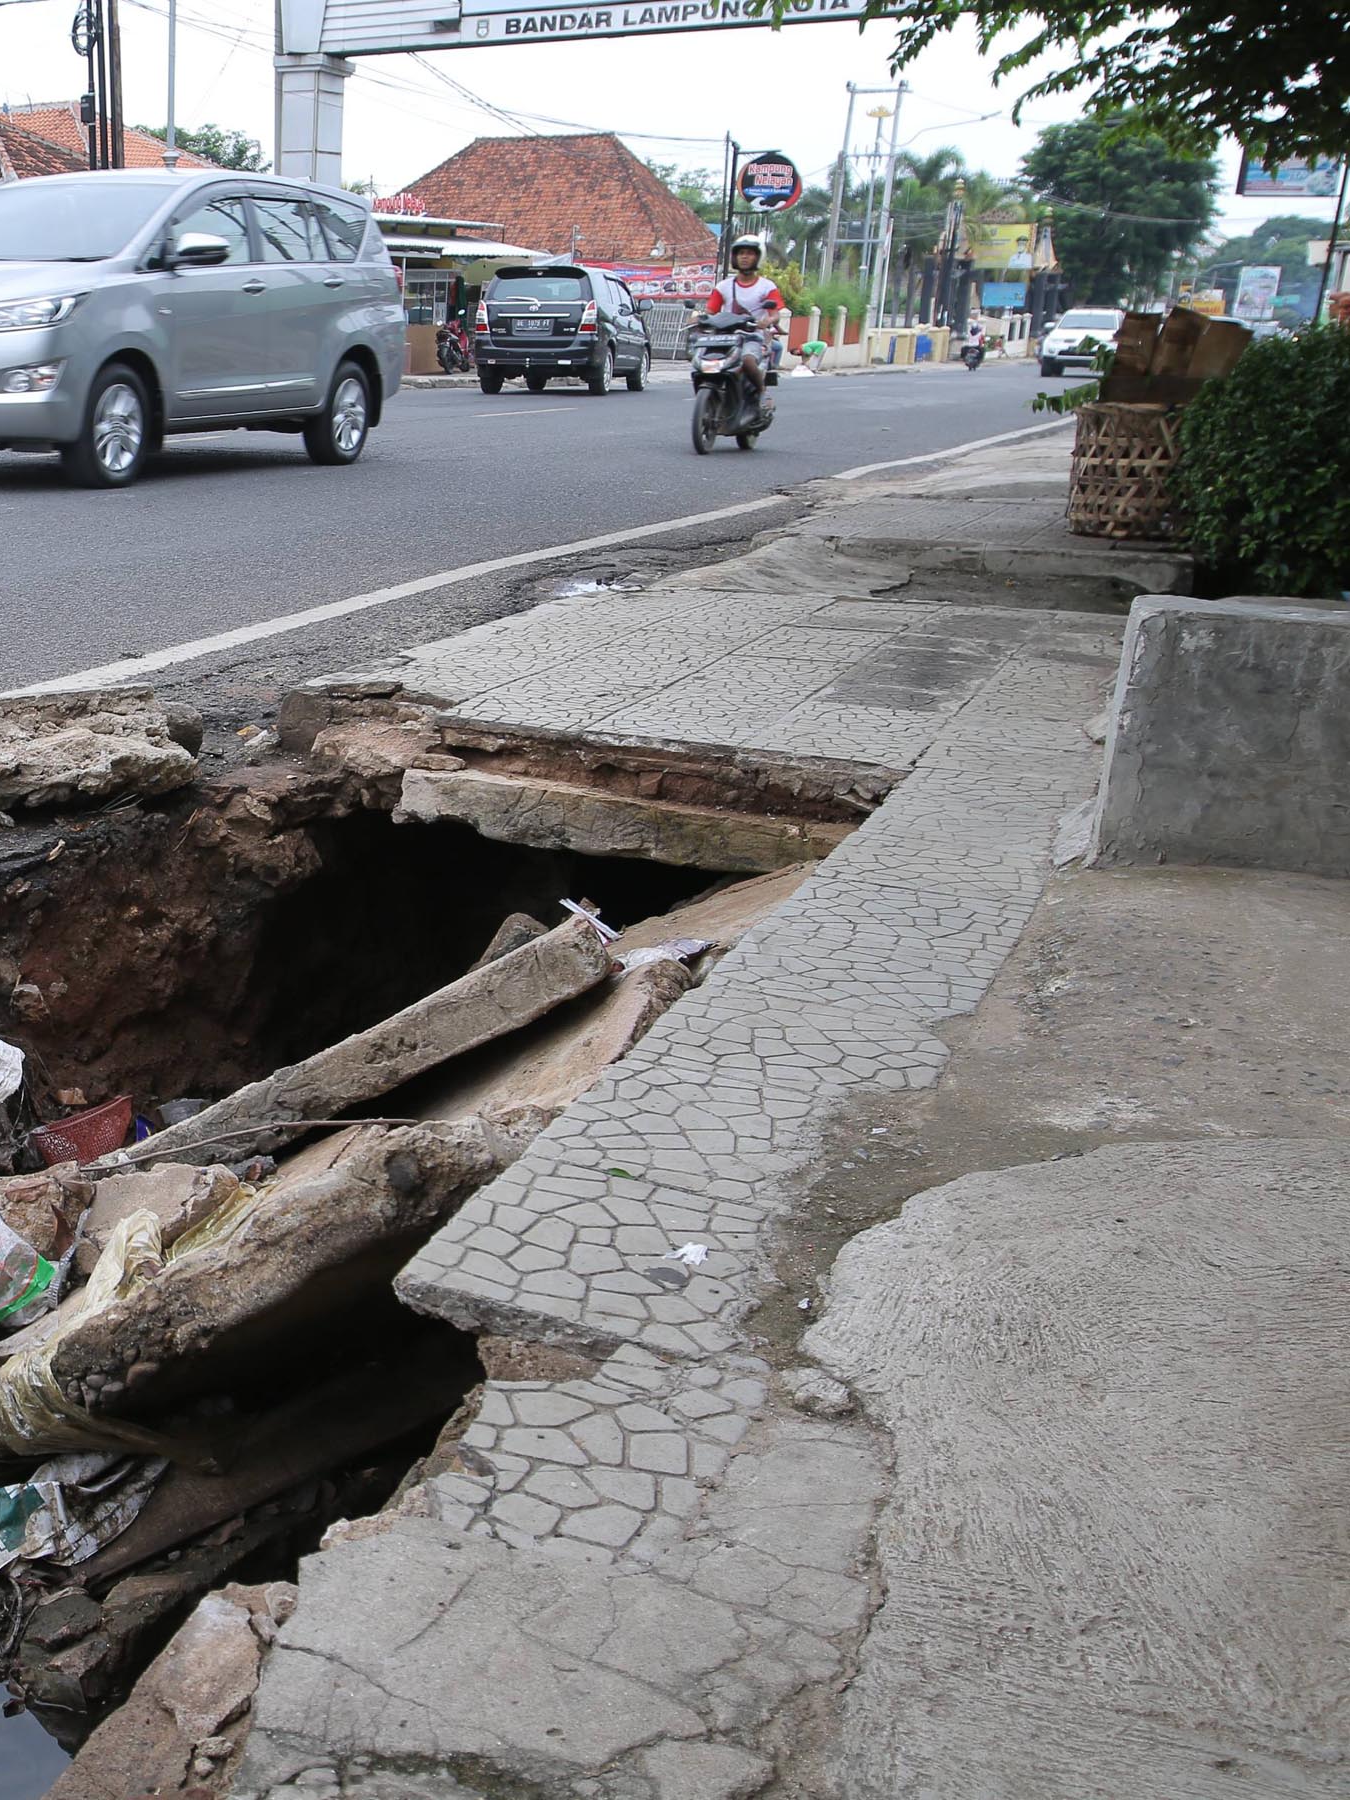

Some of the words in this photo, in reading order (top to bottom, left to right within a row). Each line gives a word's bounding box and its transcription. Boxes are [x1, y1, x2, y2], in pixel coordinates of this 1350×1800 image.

[505, 11, 612, 35] BANDAR
[748, 163, 793, 177] Kampung
[755, 174, 793, 188] Nelayan
